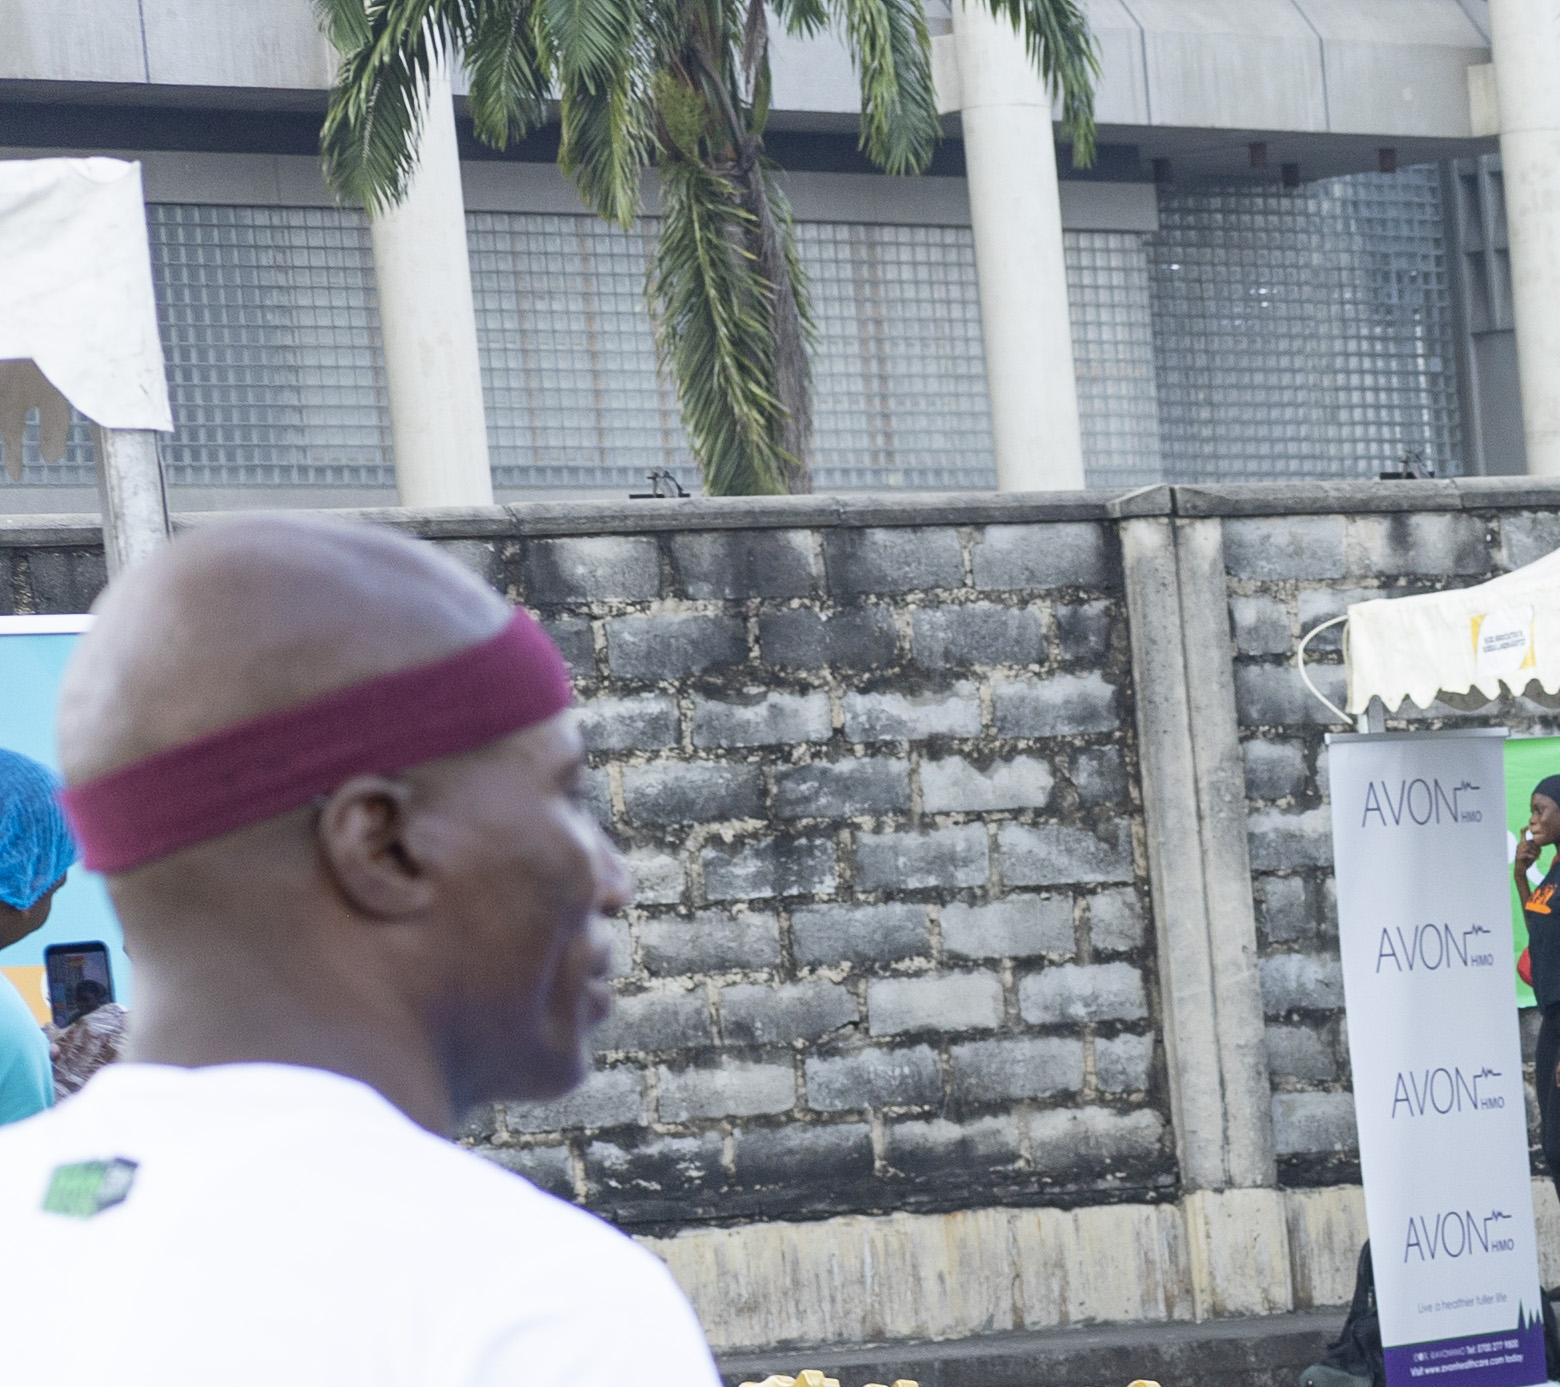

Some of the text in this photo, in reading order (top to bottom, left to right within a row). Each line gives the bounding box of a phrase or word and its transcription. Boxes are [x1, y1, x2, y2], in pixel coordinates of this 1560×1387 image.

[1362, 778, 1483, 828] AVON HMO
[1376, 923, 1495, 973] AVON HMO
[1392, 1067, 1505, 1119] AVON HMO
[1404, 1210, 1515, 1263] AVON HMO
